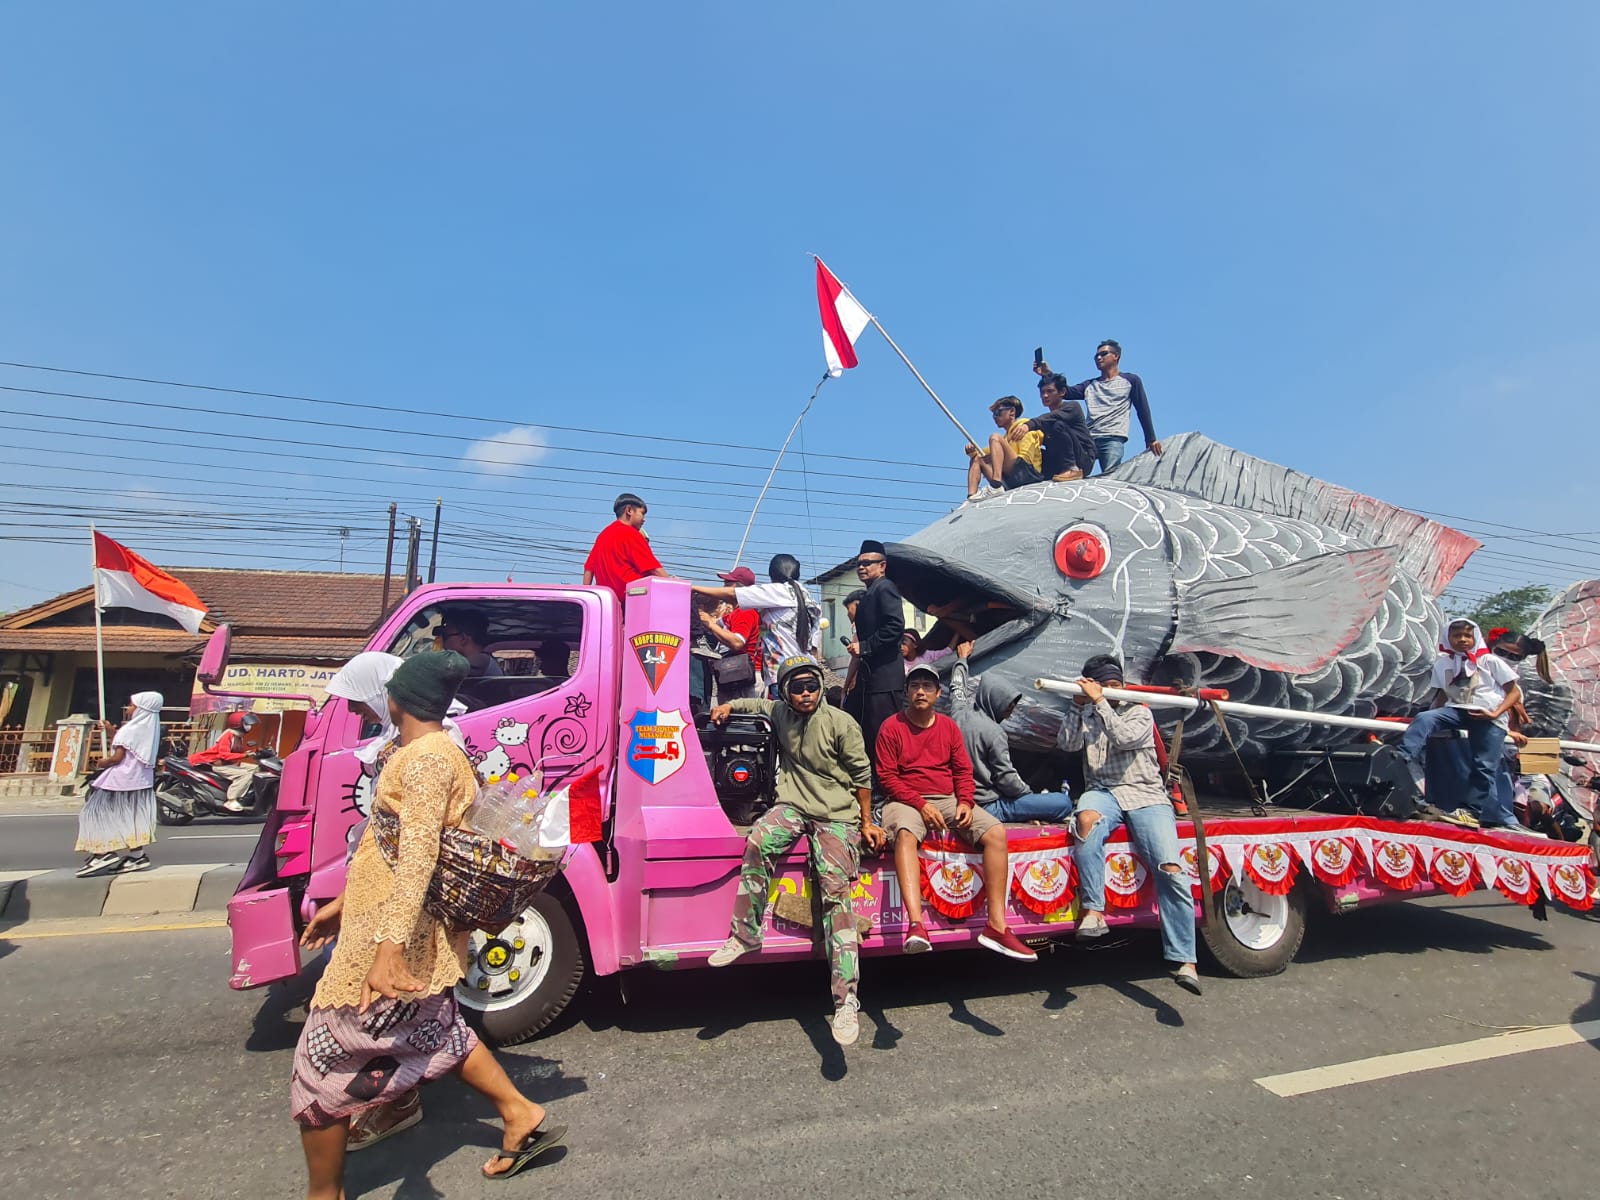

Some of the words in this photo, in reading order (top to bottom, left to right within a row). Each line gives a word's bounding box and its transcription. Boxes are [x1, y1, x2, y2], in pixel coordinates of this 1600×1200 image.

[633, 633, 654, 647] KORPS
[227, 668, 251, 678] UD.
[256, 668, 305, 678] HARTO
